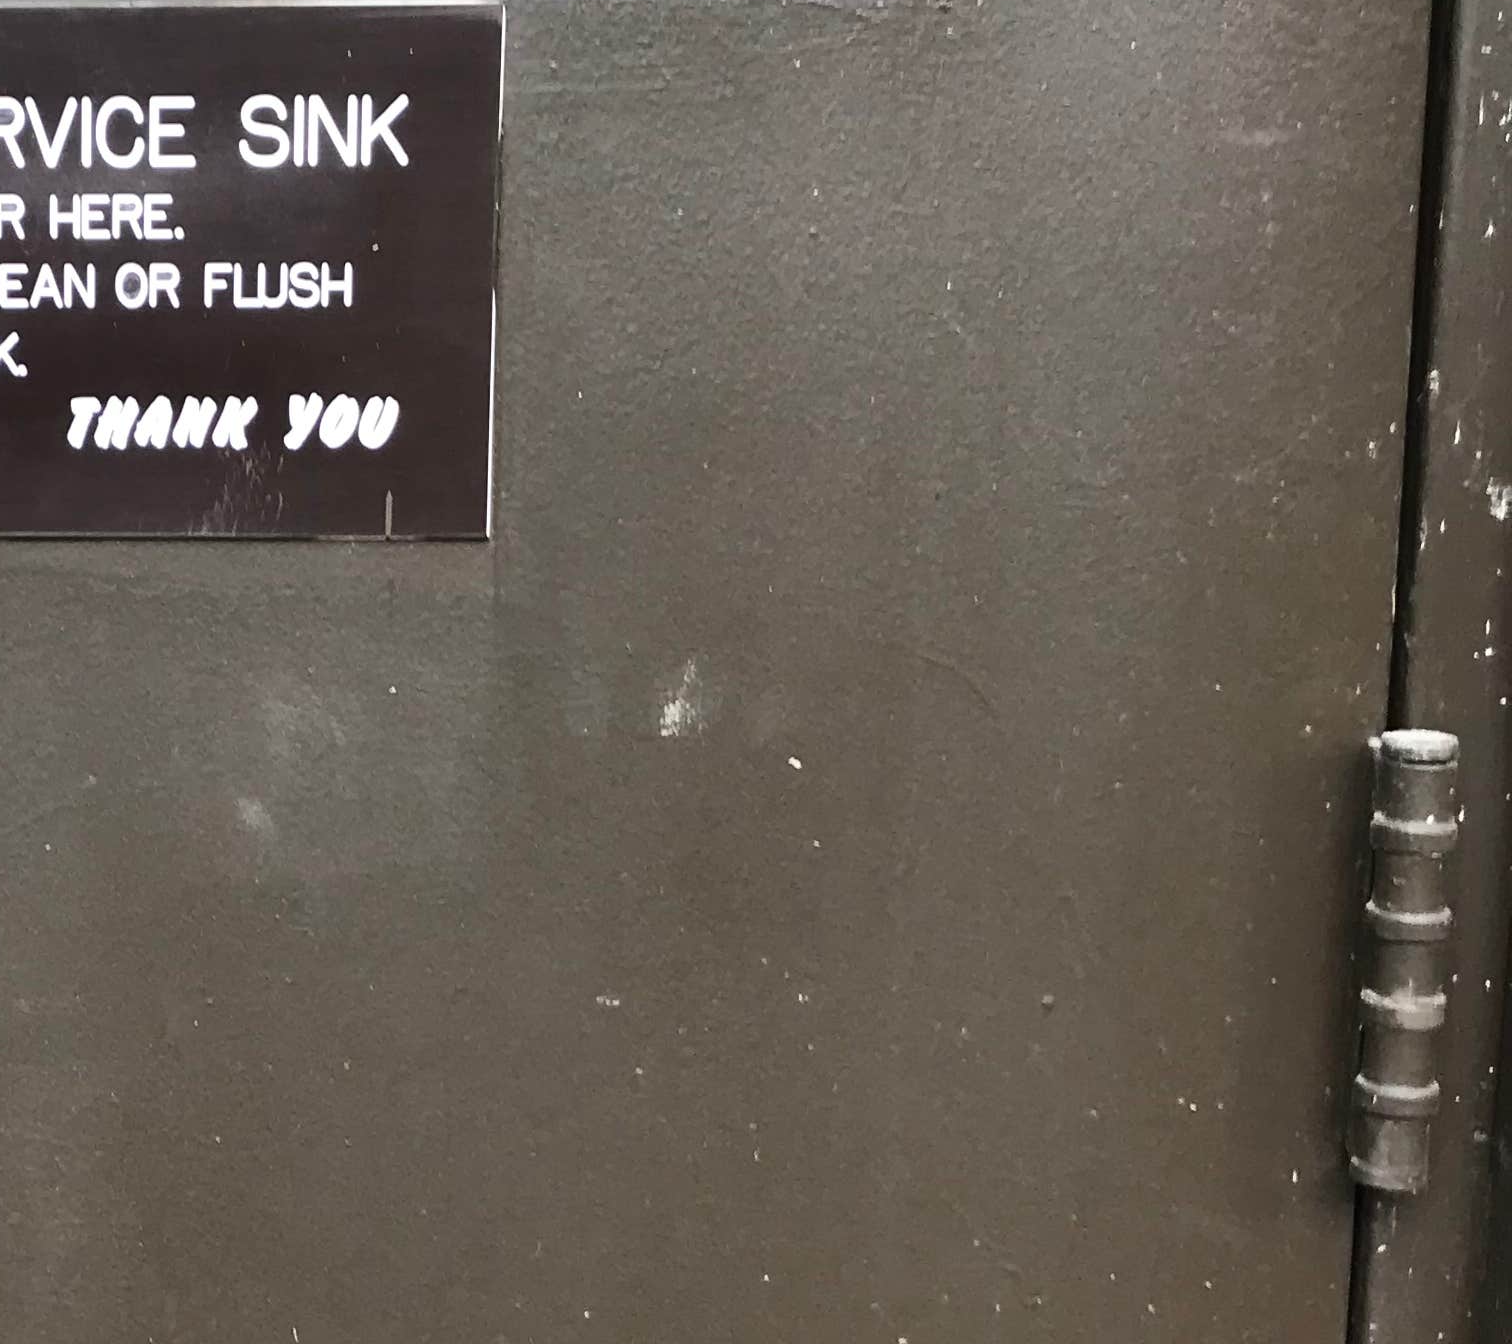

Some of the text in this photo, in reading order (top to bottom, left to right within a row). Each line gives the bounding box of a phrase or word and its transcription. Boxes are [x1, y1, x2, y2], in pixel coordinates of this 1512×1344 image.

[238, 93, 410, 169] SINK
[48, 192, 185, 241] HERE.
[114, 262, 181, 310] OR
[203, 261, 354, 309] FLUSH
[66, 392, 400, 452] THANK YOU
